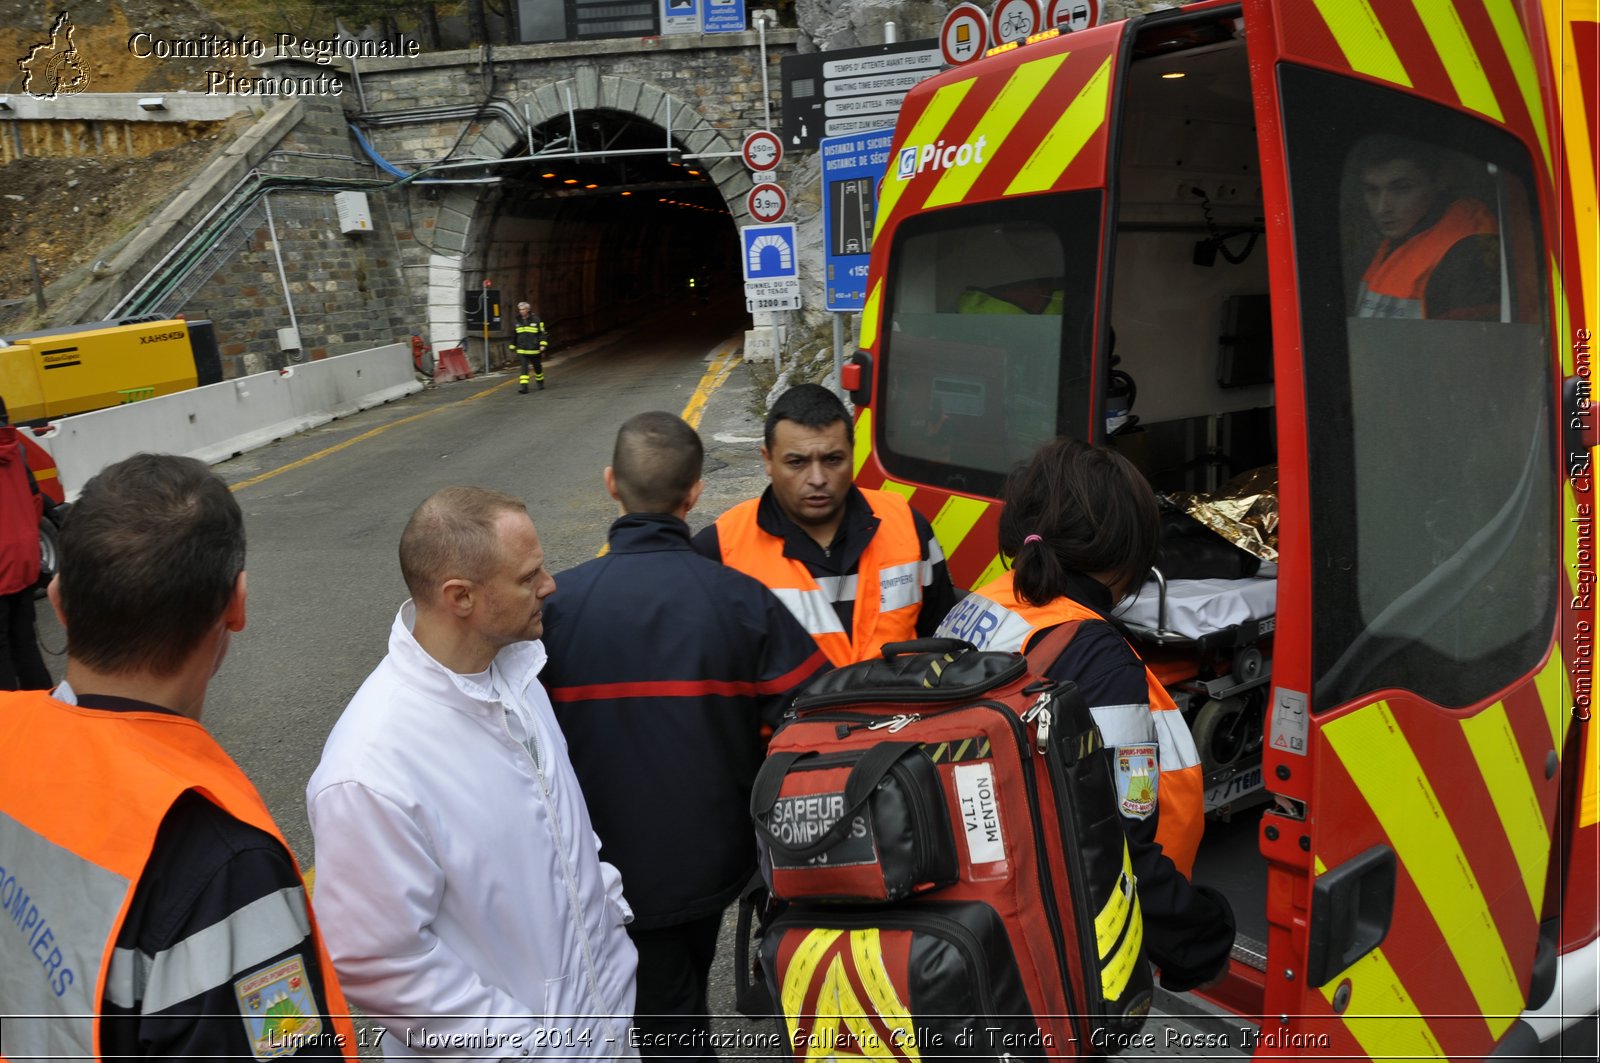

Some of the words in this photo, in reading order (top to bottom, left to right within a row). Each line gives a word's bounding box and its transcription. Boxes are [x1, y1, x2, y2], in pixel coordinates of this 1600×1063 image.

[834, 64, 853, 73] TEMPS
[861, 60, 885, 69] ATTENTE
[886, 58, 904, 67] AVANT
[905, 56, 917, 65] FEU
[917, 54, 932, 64] VERT
[834, 82, 857, 92] WAITING
[858, 80, 871, 90] TIME
[872, 79, 895, 89] BEFORE
[896, 76, 916, 86] GREEN
[836, 102, 854, 112] TEMPO
[861, 100, 882, 109] ATTESA
[859, 120, 871, 129] ZUM
[824, 142, 855, 157] DISTANZA
[857, 140, 865, 151] DI
[867, 136, 894, 150] SICURE
[917, 134, 987, 174] Picot
[826, 156, 857, 171] DISTANCE
[859, 154, 868, 166] DE
[755, 198, 779, 209] 3,9m
[758, 299, 779, 308] 3200
[139, 333, 168, 344] XAHS
[977, 776, 999, 842] MENTON
[771, 816, 867, 844] POMPIES
